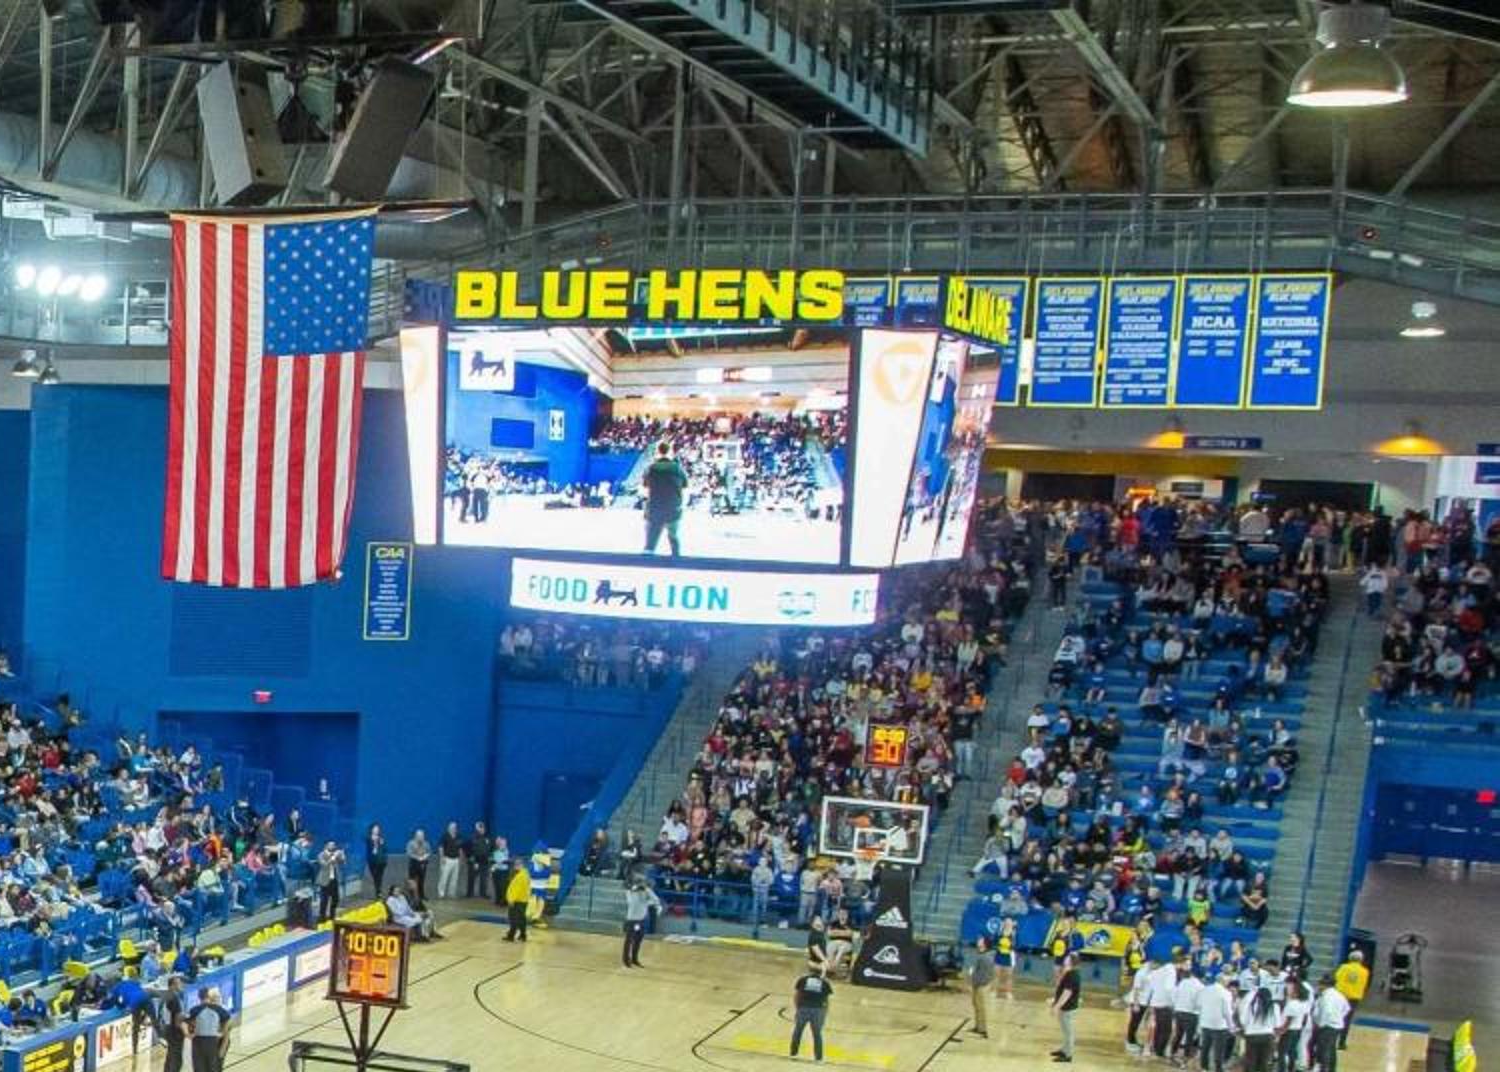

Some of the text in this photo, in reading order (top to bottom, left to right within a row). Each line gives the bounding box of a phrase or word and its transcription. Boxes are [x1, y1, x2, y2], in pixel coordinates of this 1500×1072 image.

[455, 270, 631, 320] BLUE
[647, 269, 845, 320] HENS
[945, 276, 1013, 346] DELAWARE
[1191, 316, 1236, 329] NCAA
[375, 547, 405, 558] CAA
[528, 575, 729, 611] FOOD LION
[873, 741, 899, 763] 30
[346, 932, 399, 957] 10:00
